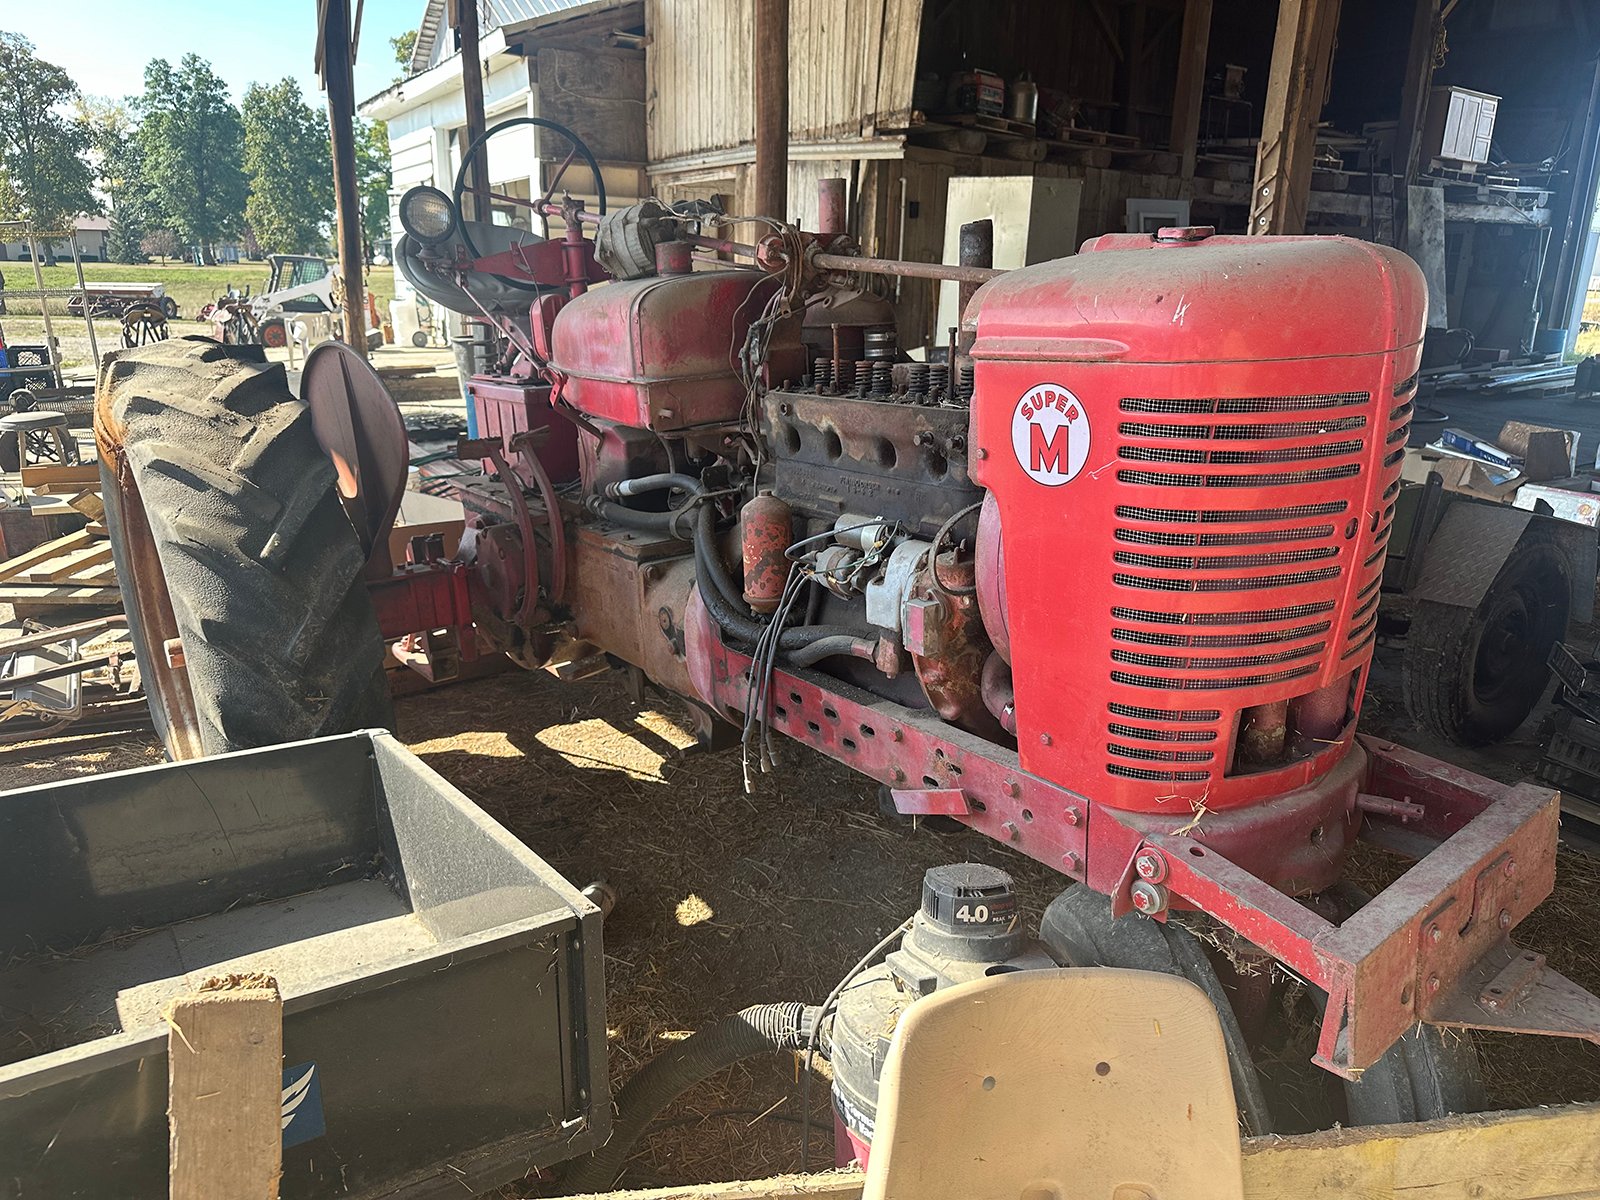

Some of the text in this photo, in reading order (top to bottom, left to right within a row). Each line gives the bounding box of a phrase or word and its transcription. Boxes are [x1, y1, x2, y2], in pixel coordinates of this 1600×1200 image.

[1021, 390, 1079, 424] SUPER
[1030, 422, 1069, 475] M
[956, 904, 989, 923] 4.0
